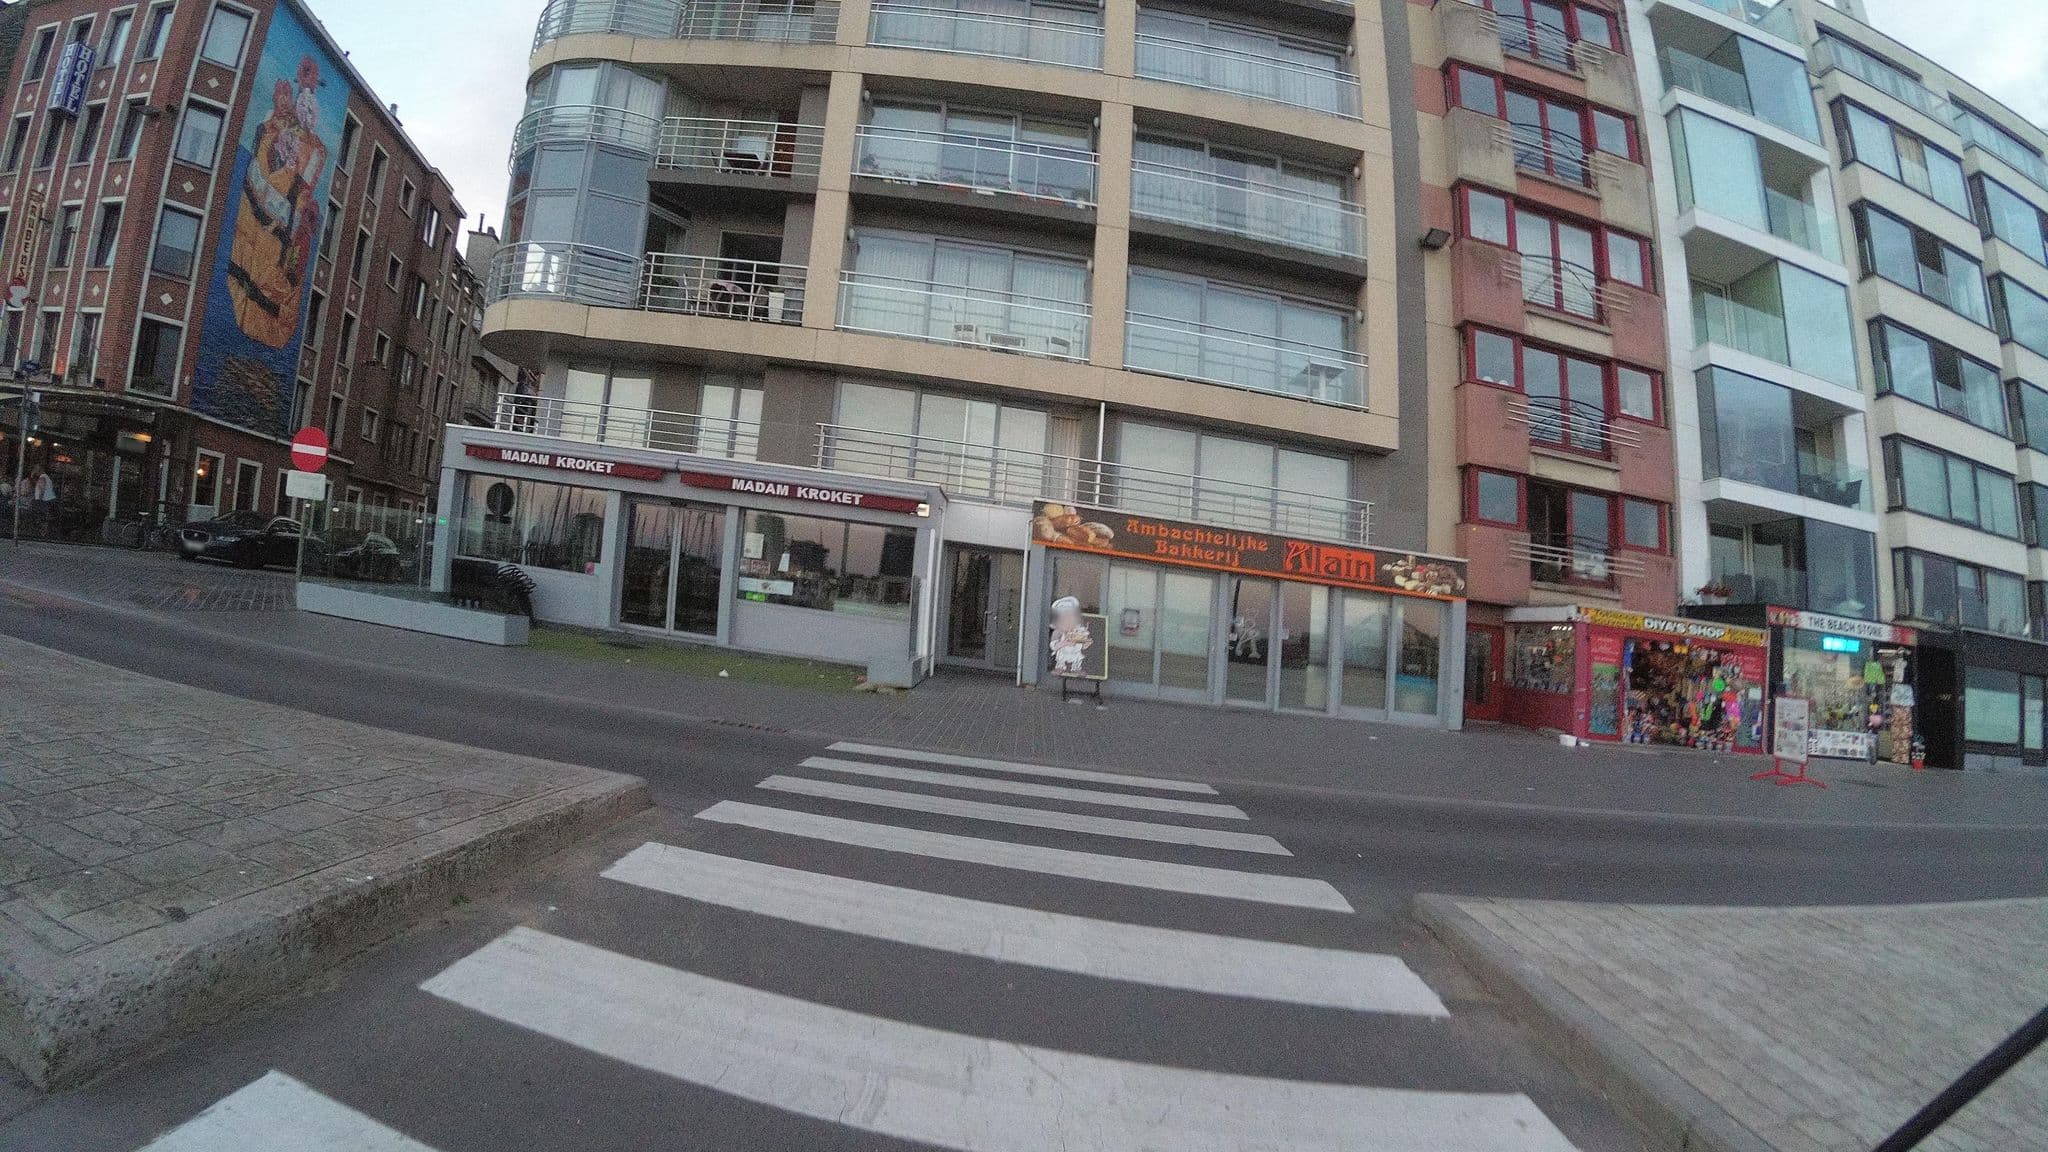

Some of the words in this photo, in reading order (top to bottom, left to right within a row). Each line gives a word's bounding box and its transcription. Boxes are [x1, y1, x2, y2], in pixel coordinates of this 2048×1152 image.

[52, 44, 75, 106] HOTEL
[66, 44, 92, 112] HOTEL
[501, 444, 550, 465] MADAM
[556, 456, 615, 474] KROKET
[731, 478, 789, 496] MADAM
[796, 486, 863, 505] KROKET
[1126, 519, 1268, 551] Ambachtelijke
[1156, 540, 1240, 567] Bakkerij
[1284, 540, 1375, 579] Alain
[1644, 617, 1687, 634] DIYA'S
[1688, 623, 1725, 638] SHOP
[1808, 617, 1825, 629] THE
[1827, 619, 1855, 633] BEACH
[1857, 624, 1884, 638] STORE
